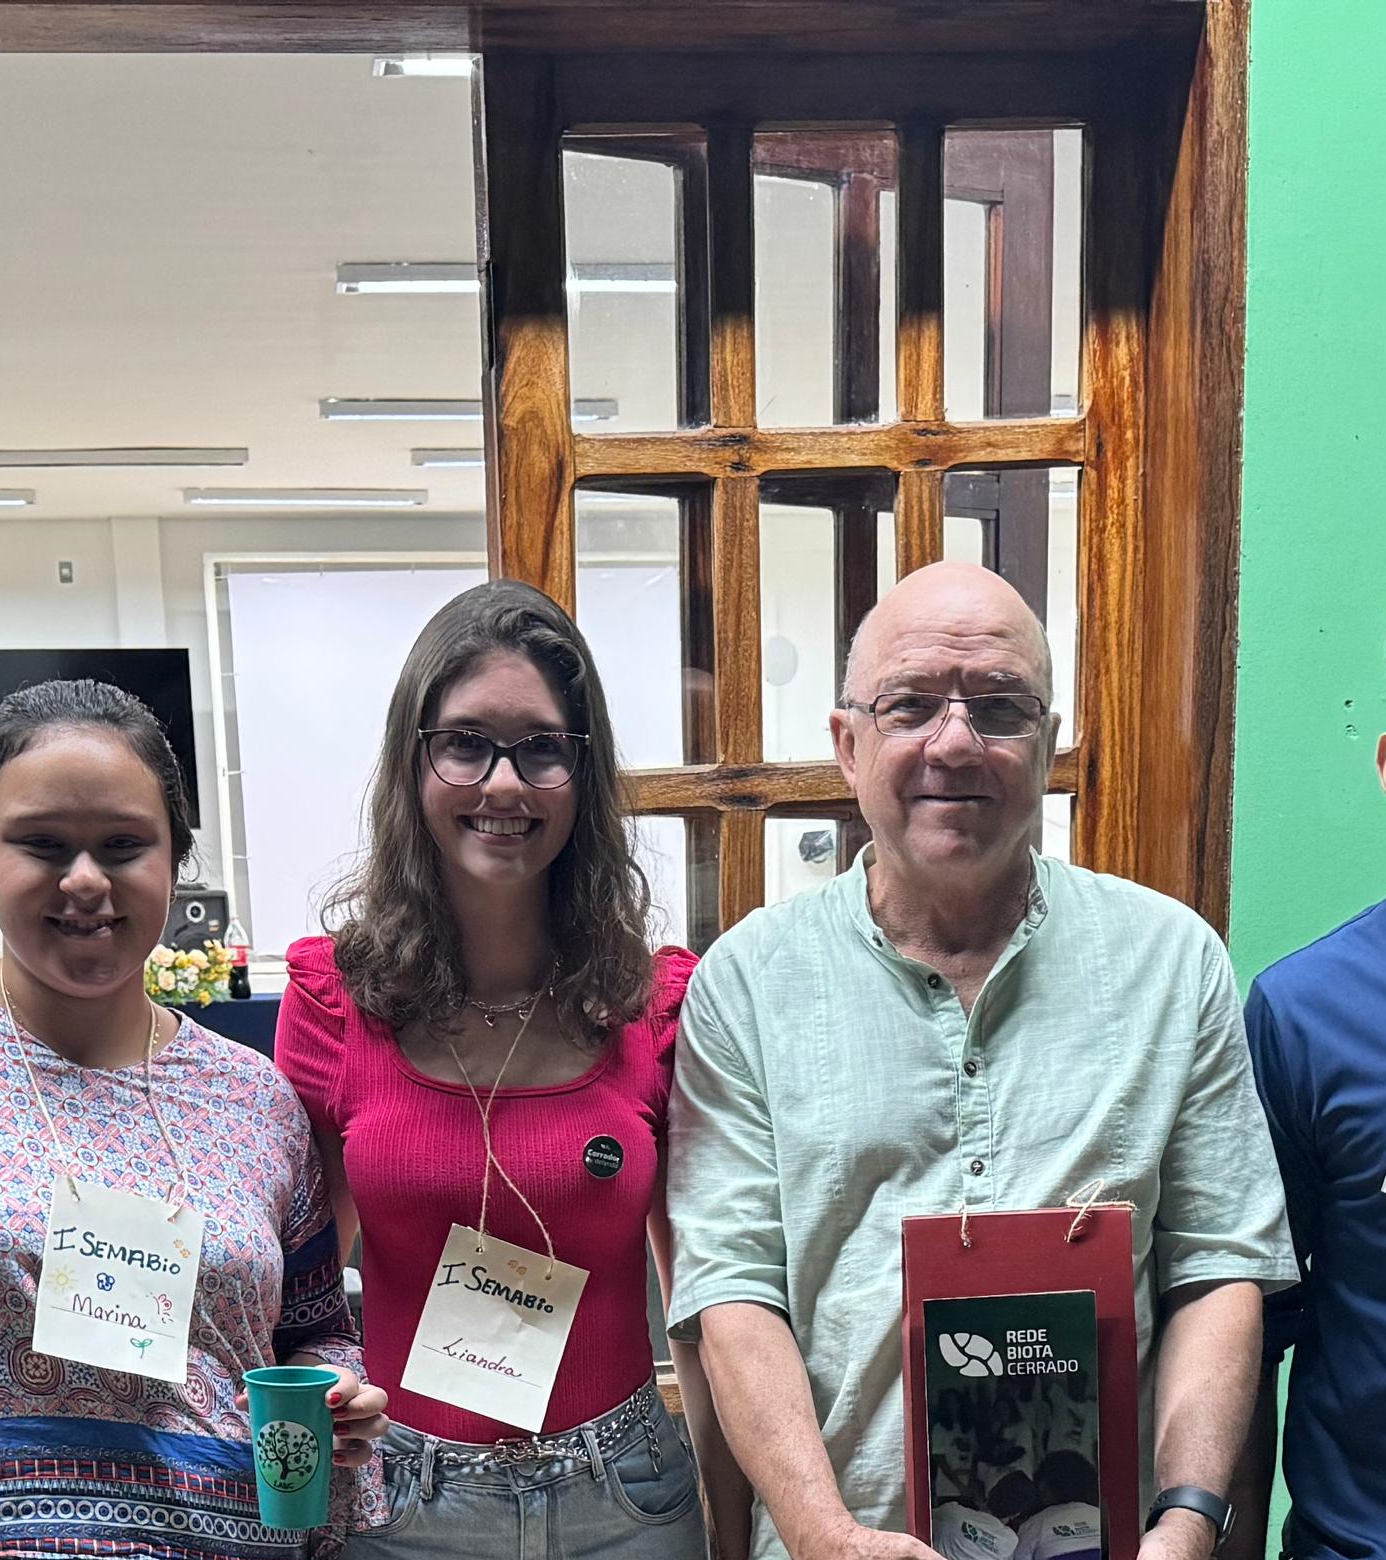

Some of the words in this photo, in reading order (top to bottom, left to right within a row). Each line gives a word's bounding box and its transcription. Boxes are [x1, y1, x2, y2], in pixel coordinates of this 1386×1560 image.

[72, 1293, 147, 1330] Marina
[1006, 1328, 1048, 1343] REDE
[1006, 1344, 1053, 1360] BIOTA
[1007, 1359, 1079, 1376] CERRADO
